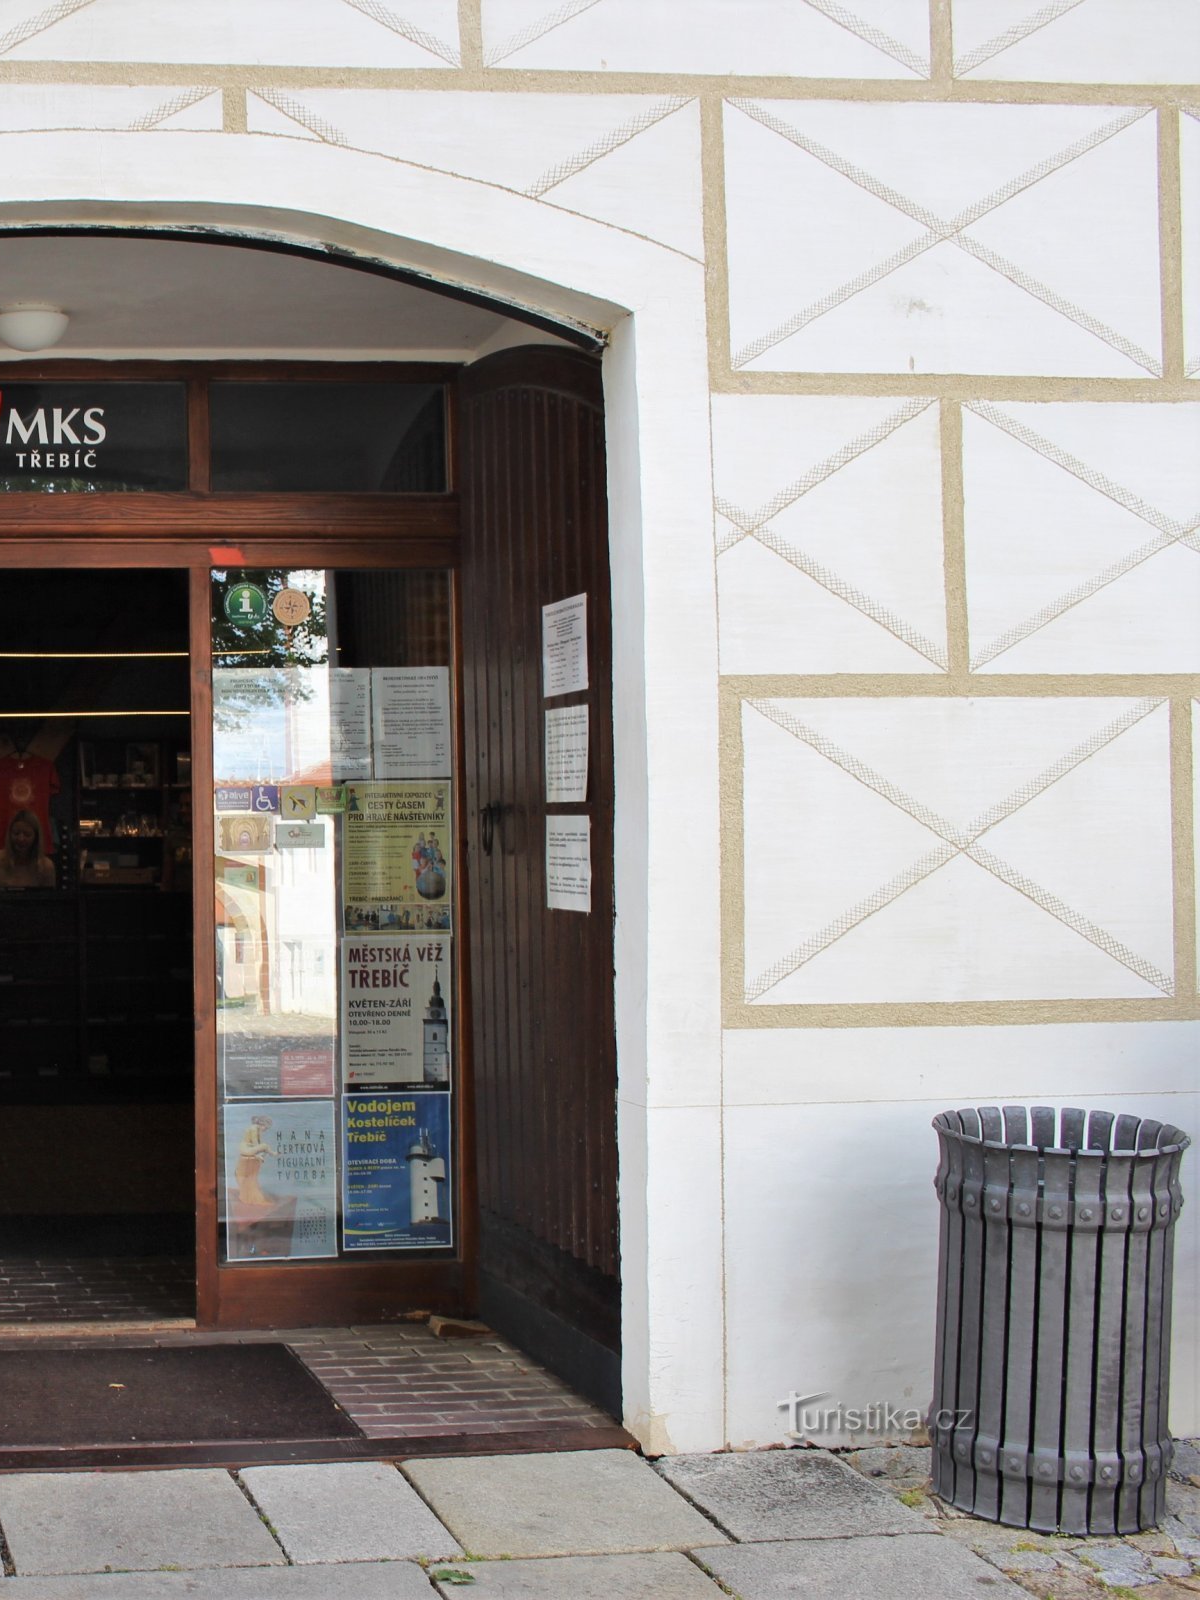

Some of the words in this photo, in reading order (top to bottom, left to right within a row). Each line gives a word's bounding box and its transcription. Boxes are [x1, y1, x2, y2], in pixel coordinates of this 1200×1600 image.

[6, 408, 107, 445] MKS
[16, 450, 97, 468] TŘEBÍČ
[368, 801, 394, 809] CESTY
[396, 799, 425, 809] ČASEM
[348, 813, 364, 821] PRO
[394, 811, 445, 821] NÁVŠTĚVNÍKY
[348, 944, 411, 962] MĚSTSKÁ
[417, 943, 443, 961] VĚŽ
[348, 964, 409, 988] TŘEBÍČ
[348, 998, 411, 1008] KVĚTEN-ZÁŘÍ
[348, 1010, 386, 1018] OTEVŘENO
[347, 1099, 416, 1115] Vodojem
[347, 1116, 416, 1128] Kostelíček
[276, 1131, 325, 1140] HANA
[347, 1131, 387, 1143] Třebíč
[277, 1141, 325, 1154] ČERTKOVÁ
[277, 1156, 326, 1168] FIGURÁLNÍ
[277, 1170, 326, 1181] TVORBA
